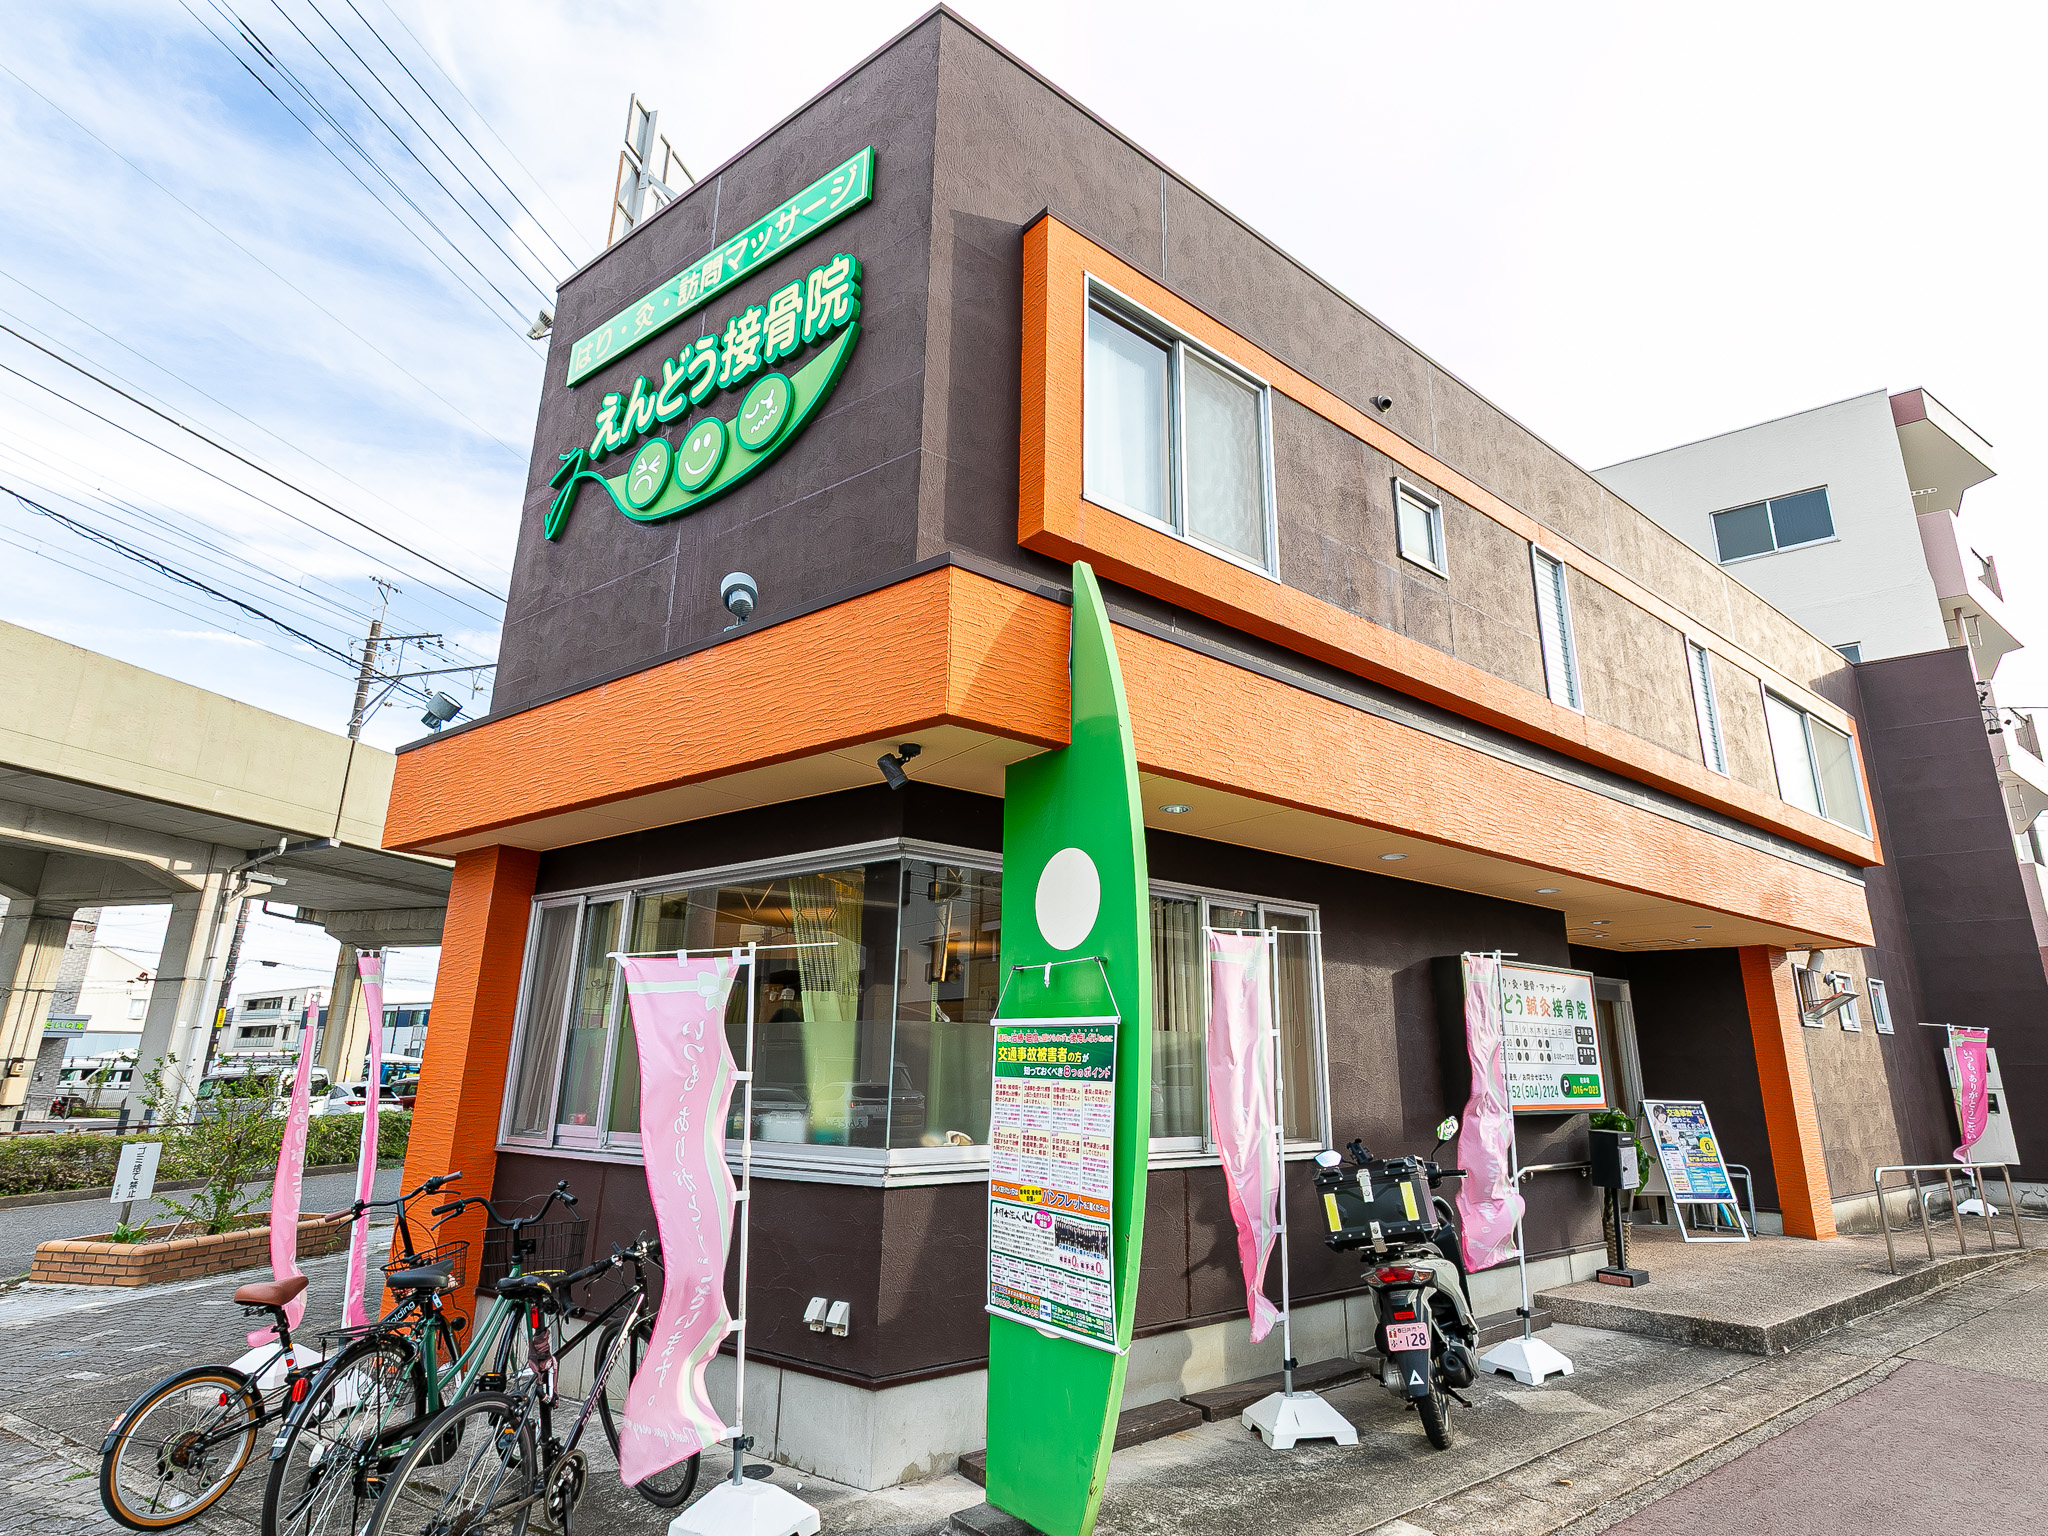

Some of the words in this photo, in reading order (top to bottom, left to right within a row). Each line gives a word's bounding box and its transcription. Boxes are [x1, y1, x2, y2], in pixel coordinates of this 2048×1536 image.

[574, 162, 858, 372] はり・灸・訪問マッサージ
[590, 256, 851, 455] えんどう接骨院
[1502, 978, 1567, 993] り・灸・整骨・マッサージ
[1503, 992, 1588, 1020] どう鍼灸接骨院
[998, 1046, 1090, 1063] 交通事故被害者の方が
[1511, 1083, 1559, 1100] 52(504)2124
[127, 1145, 147, 1199] ゴミ捨て禁止
[387, 1301, 416, 1322] olding
